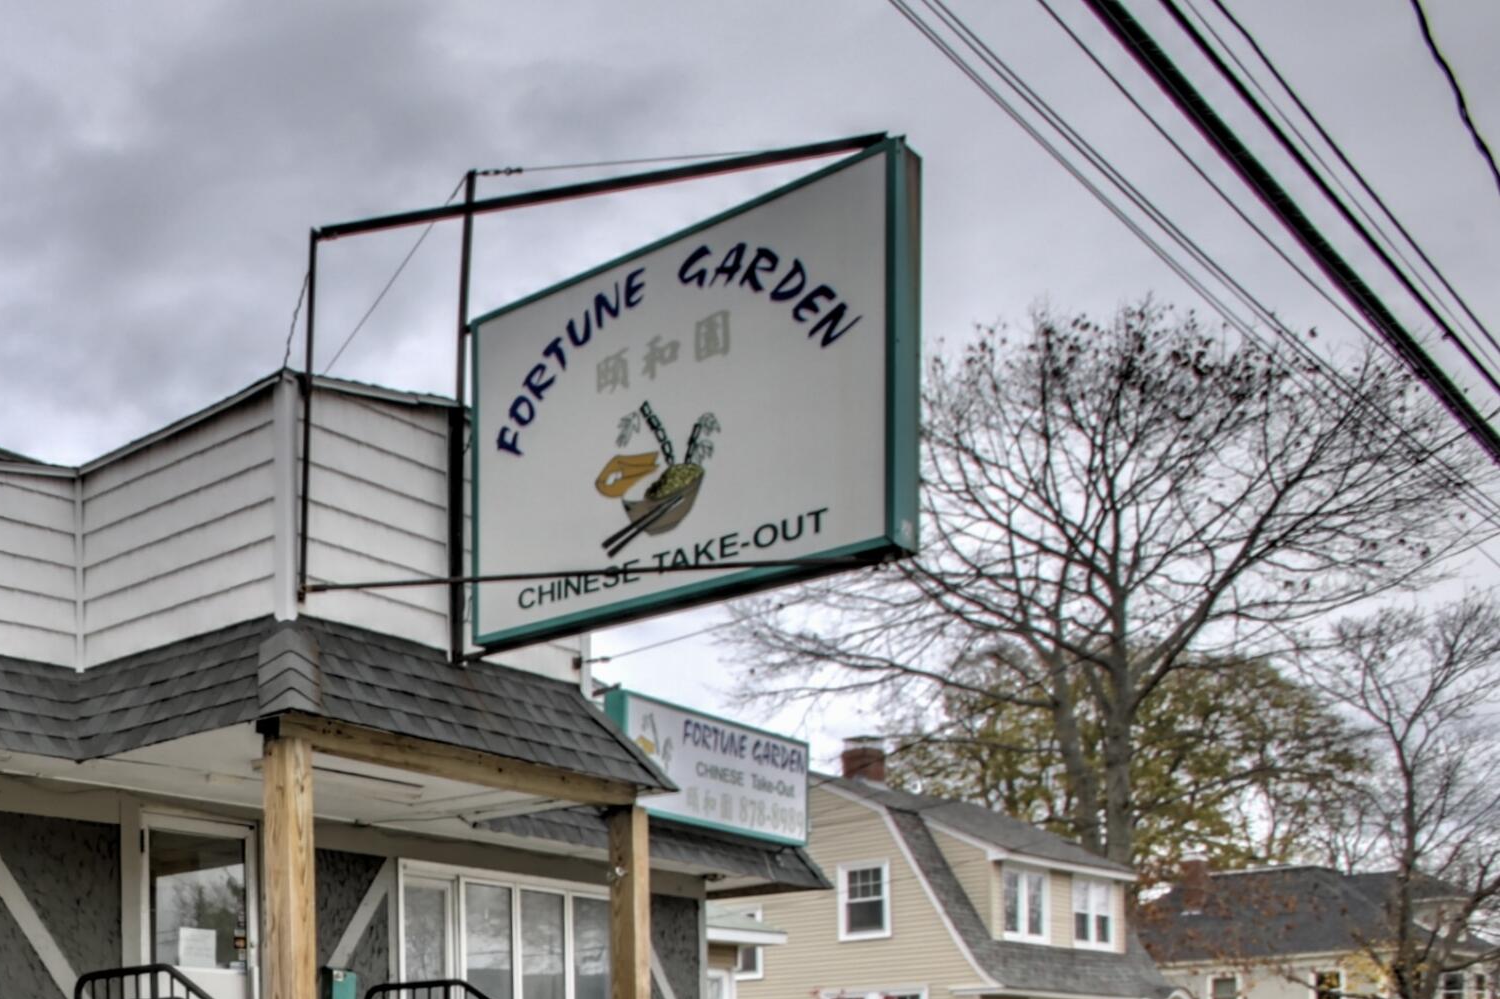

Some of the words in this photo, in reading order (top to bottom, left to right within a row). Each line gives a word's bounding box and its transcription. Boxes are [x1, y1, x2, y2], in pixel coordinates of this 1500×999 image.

[496, 267, 647, 457] FORTUNE
[678, 242, 863, 349] GARDEN
[518, 559, 640, 609] CHINESE
[652, 507, 829, 575] TAKE-OUT
[682, 719, 749, 759] FORTUNE
[752, 739, 806, 775] GARDEN
[696, 761, 744, 787] CHINESE
[739, 796, 805, 836] 878-8989
